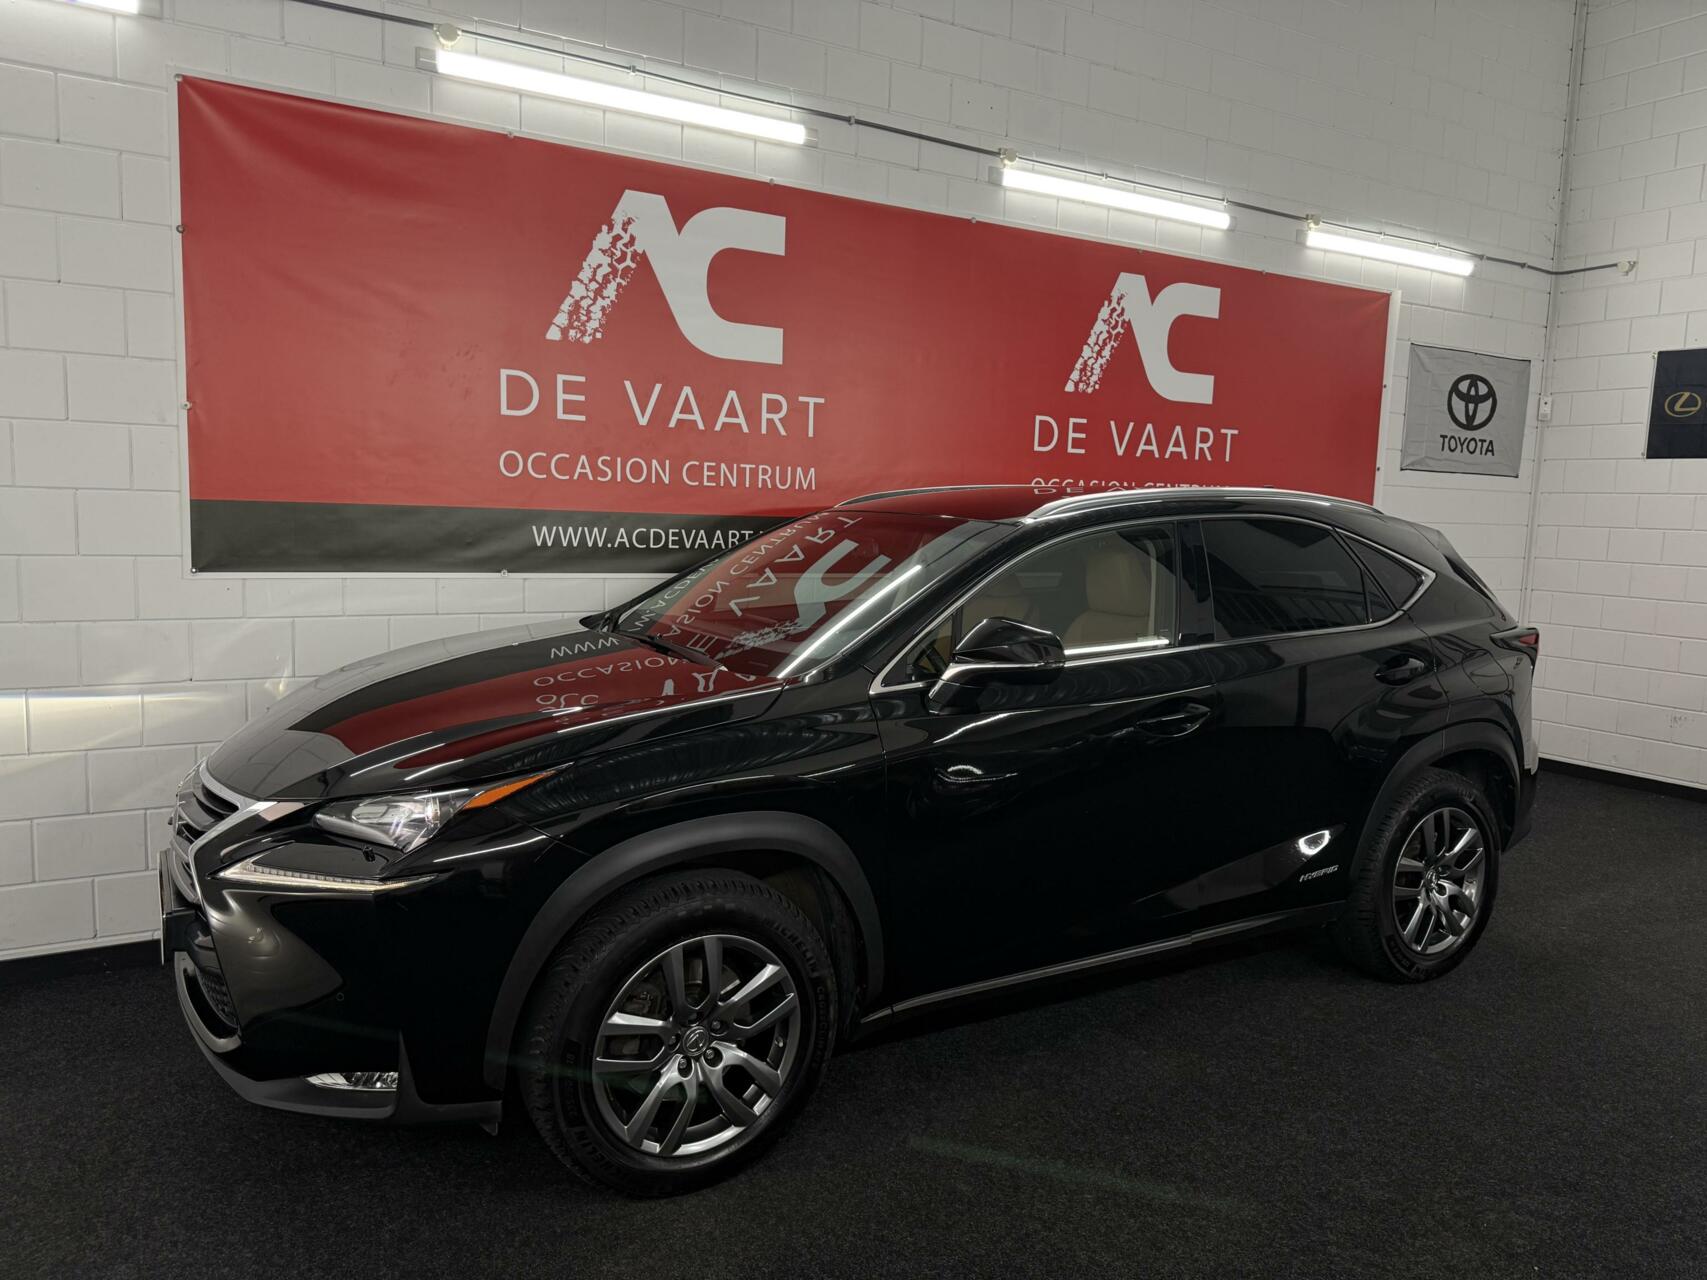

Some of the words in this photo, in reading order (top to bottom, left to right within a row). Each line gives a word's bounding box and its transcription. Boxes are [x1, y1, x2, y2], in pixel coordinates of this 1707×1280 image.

[545, 189, 786, 365] AC
[1064, 272, 1221, 404] AC
[499, 368, 587, 422] DE
[623, 380, 825, 438] VAART
[1033, 415, 1088, 454] DE
[1110, 420, 1239, 462] VAART
[1439, 434, 1495, 456] TOYOTA
[499, 449, 670, 485] OCCASION
[682, 460, 817, 490] CENTRUM
[532, 525, 764, 550] WWW.ACDEVAART
